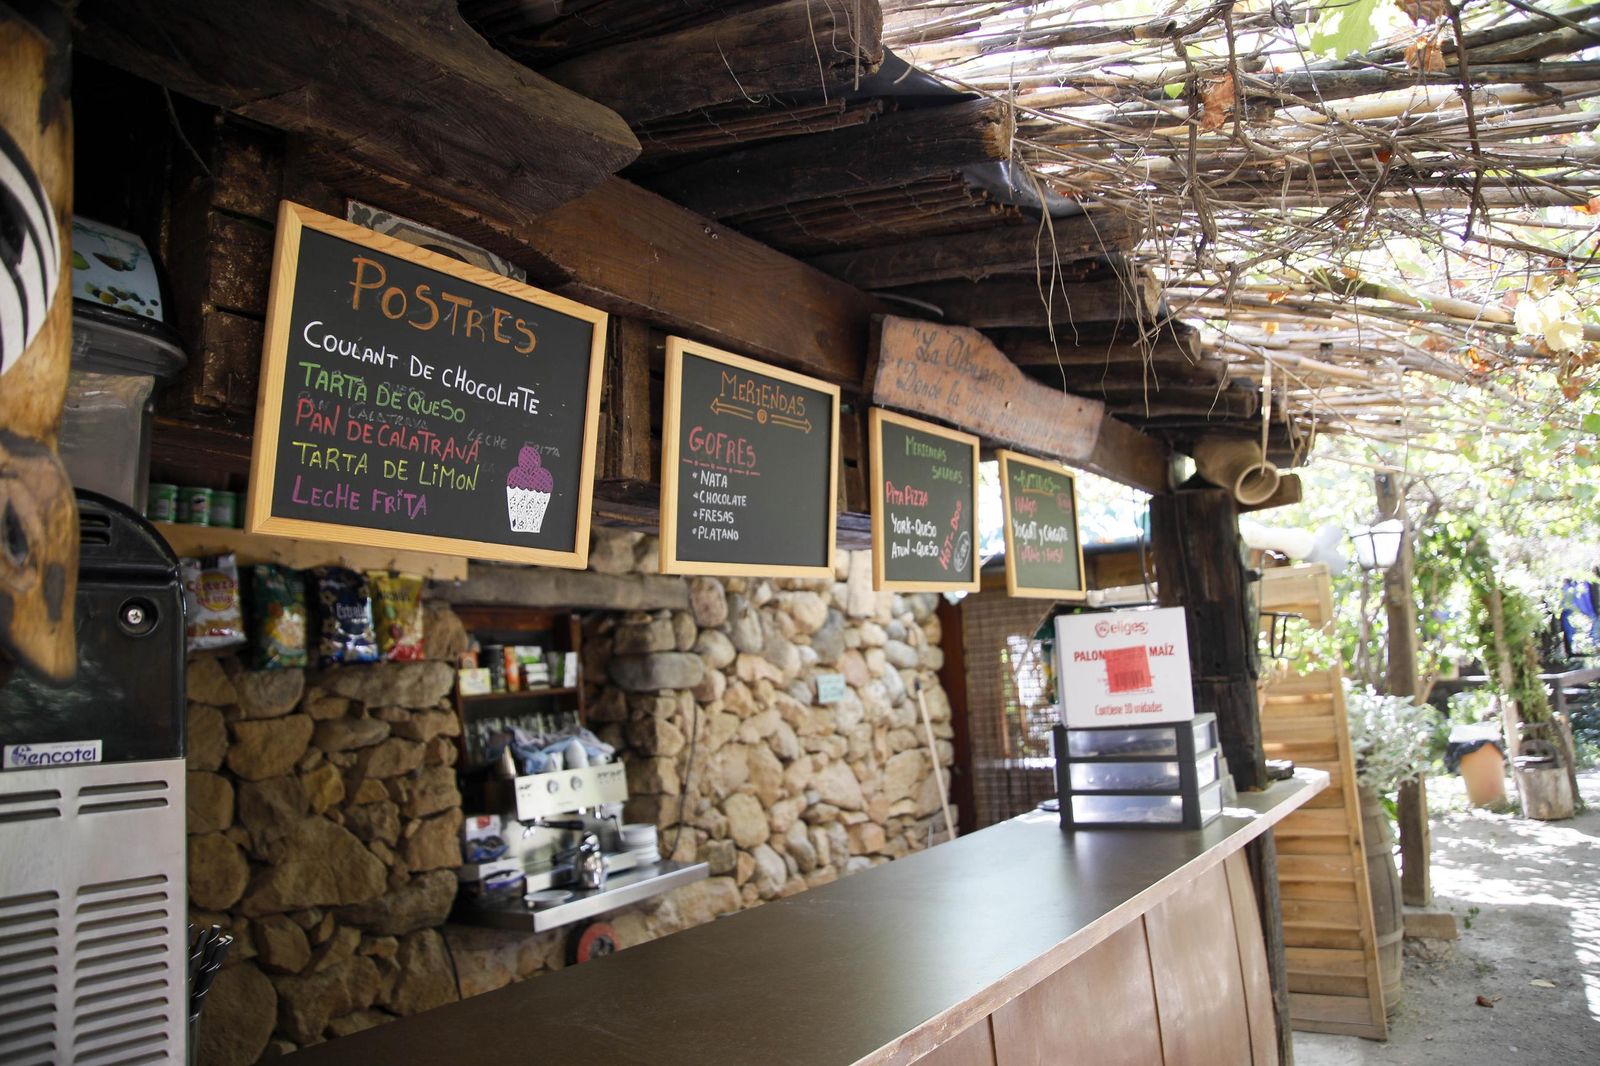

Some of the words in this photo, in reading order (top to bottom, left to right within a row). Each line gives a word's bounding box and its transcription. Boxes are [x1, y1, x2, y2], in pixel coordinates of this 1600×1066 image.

[349, 255, 537, 354] POSTRES
[303, 320, 399, 369] COULANT
[410, 355, 434, 380] DE
[442, 366, 540, 416] CHOCOLATE
[299, 362, 367, 402] TARTA
[376, 385, 402, 410] DE
[407, 391, 466, 424] QUESO
[720, 371, 806, 417] MERIENDAS
[296, 398, 341, 436] PAN
[347, 420, 374, 445] DE
[378, 427, 480, 465] CALATRAVA
[689, 426, 757, 469] GOFRES
[292, 441, 368, 475] TARTA
[384, 460, 408, 481] DE
[700, 470, 728, 488] NATA
[292, 475, 359, 511] LECHE
[699, 490, 747, 507] CHOCOLATE
[698, 526, 739, 542] PLATANO
[699, 508, 735, 524] FRESAS
[1149, 642, 1175, 657] MAÍZ
